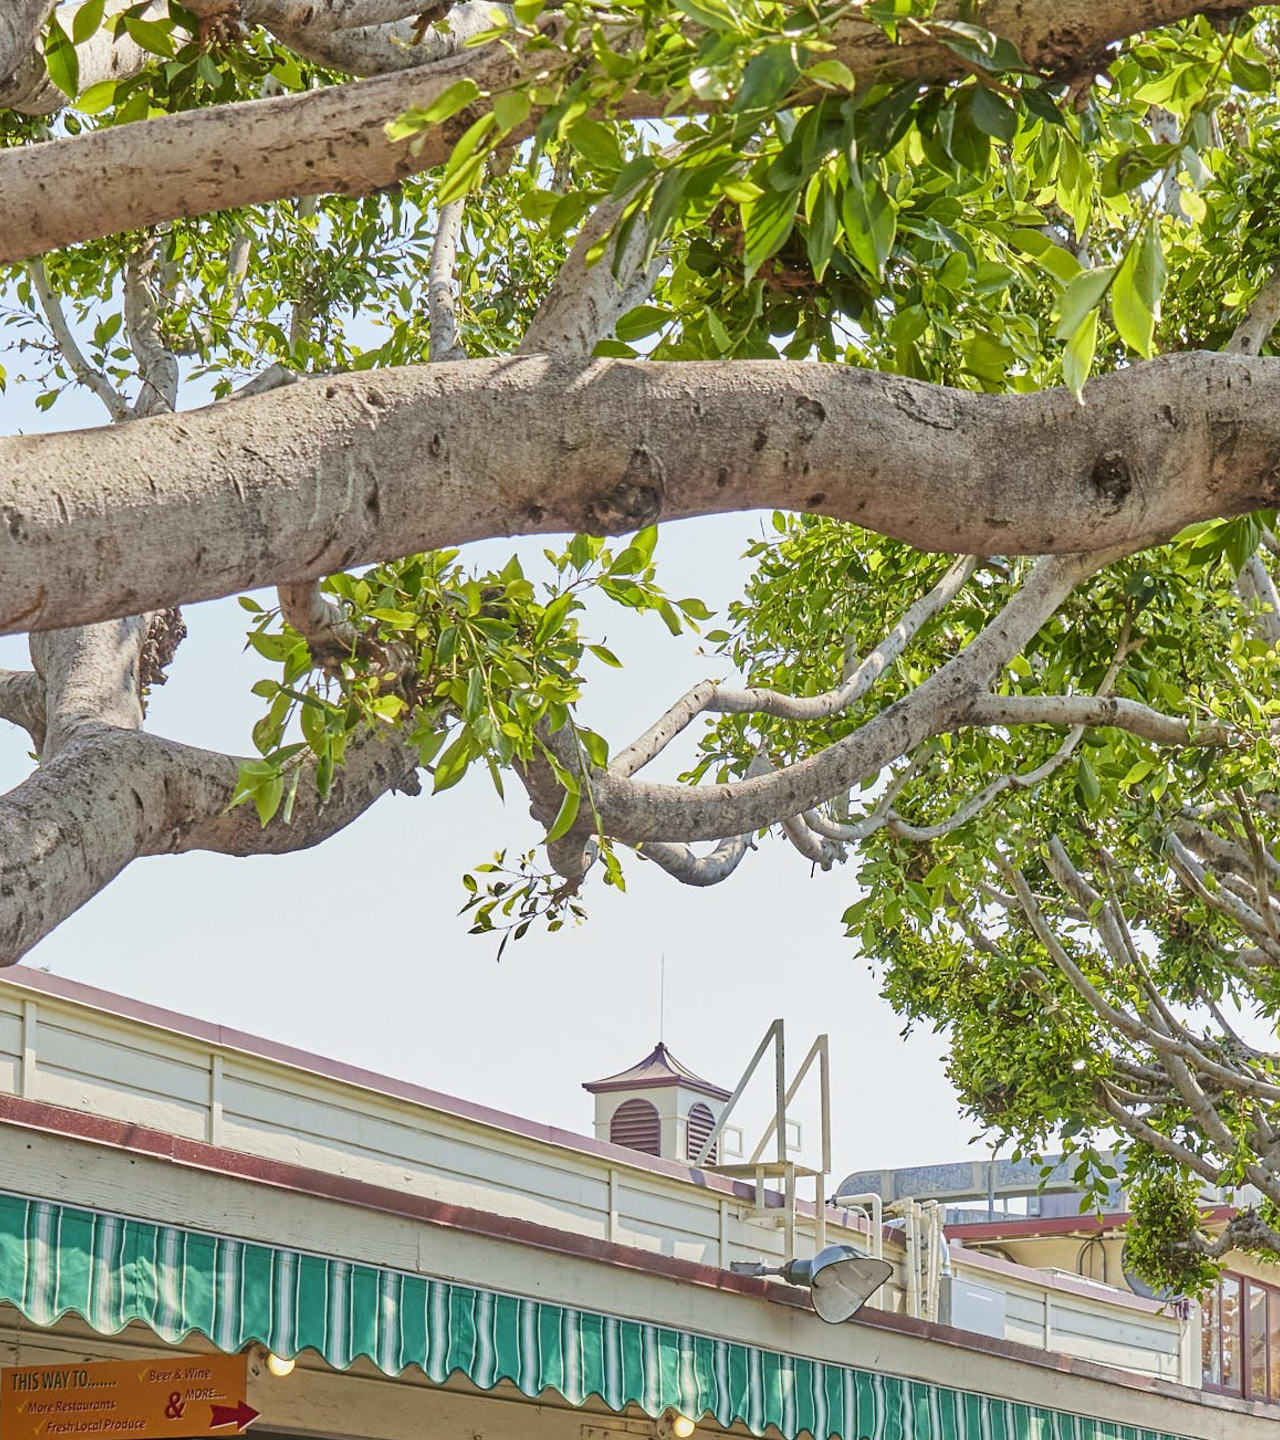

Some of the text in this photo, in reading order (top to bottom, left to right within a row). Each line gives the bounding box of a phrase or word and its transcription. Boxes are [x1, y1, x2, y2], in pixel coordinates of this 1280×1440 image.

[12, 1373, 40, 1391] THIS
[42, 1371, 70, 1390] WAY
[148, 1367, 212, 1381] Beer & Wine
[27, 1399, 117, 1414] More Restaurants
[165, 1391, 186, 1420] &
[47, 1418, 147, 1435] Fresh Local Produce
